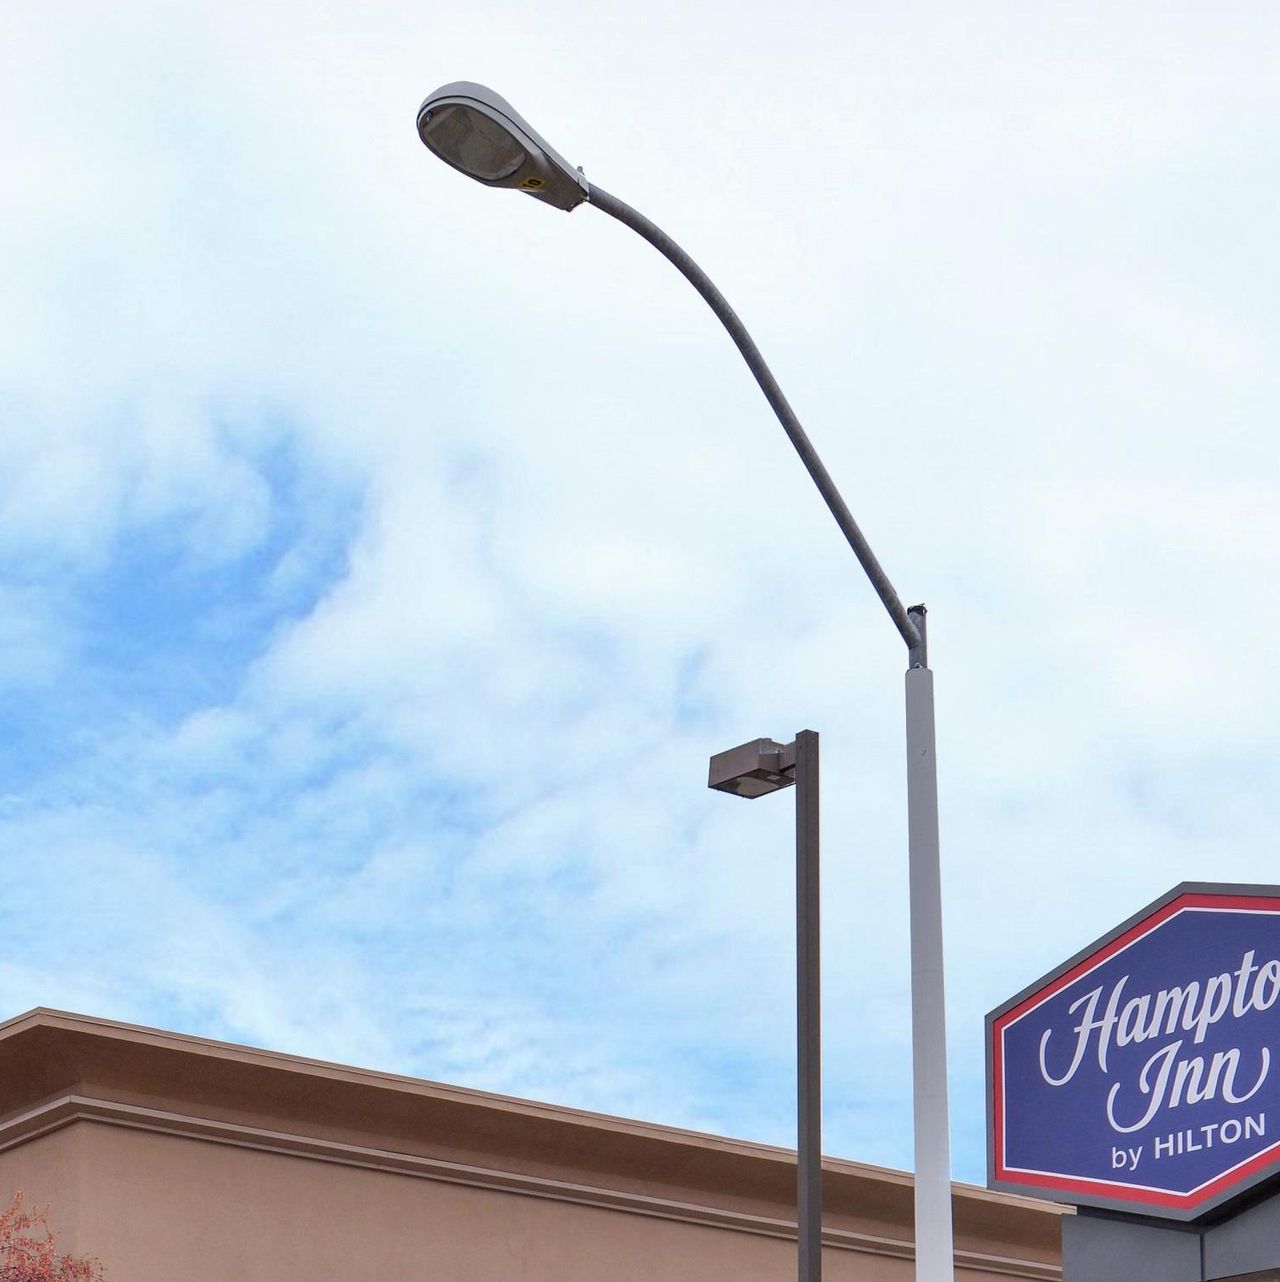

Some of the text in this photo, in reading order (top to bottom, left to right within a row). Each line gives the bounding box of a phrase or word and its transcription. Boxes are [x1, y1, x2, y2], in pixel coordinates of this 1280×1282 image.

[1106, 1040, 1270, 1133] Inn
[1111, 1112, 1266, 1170] by HILTON
